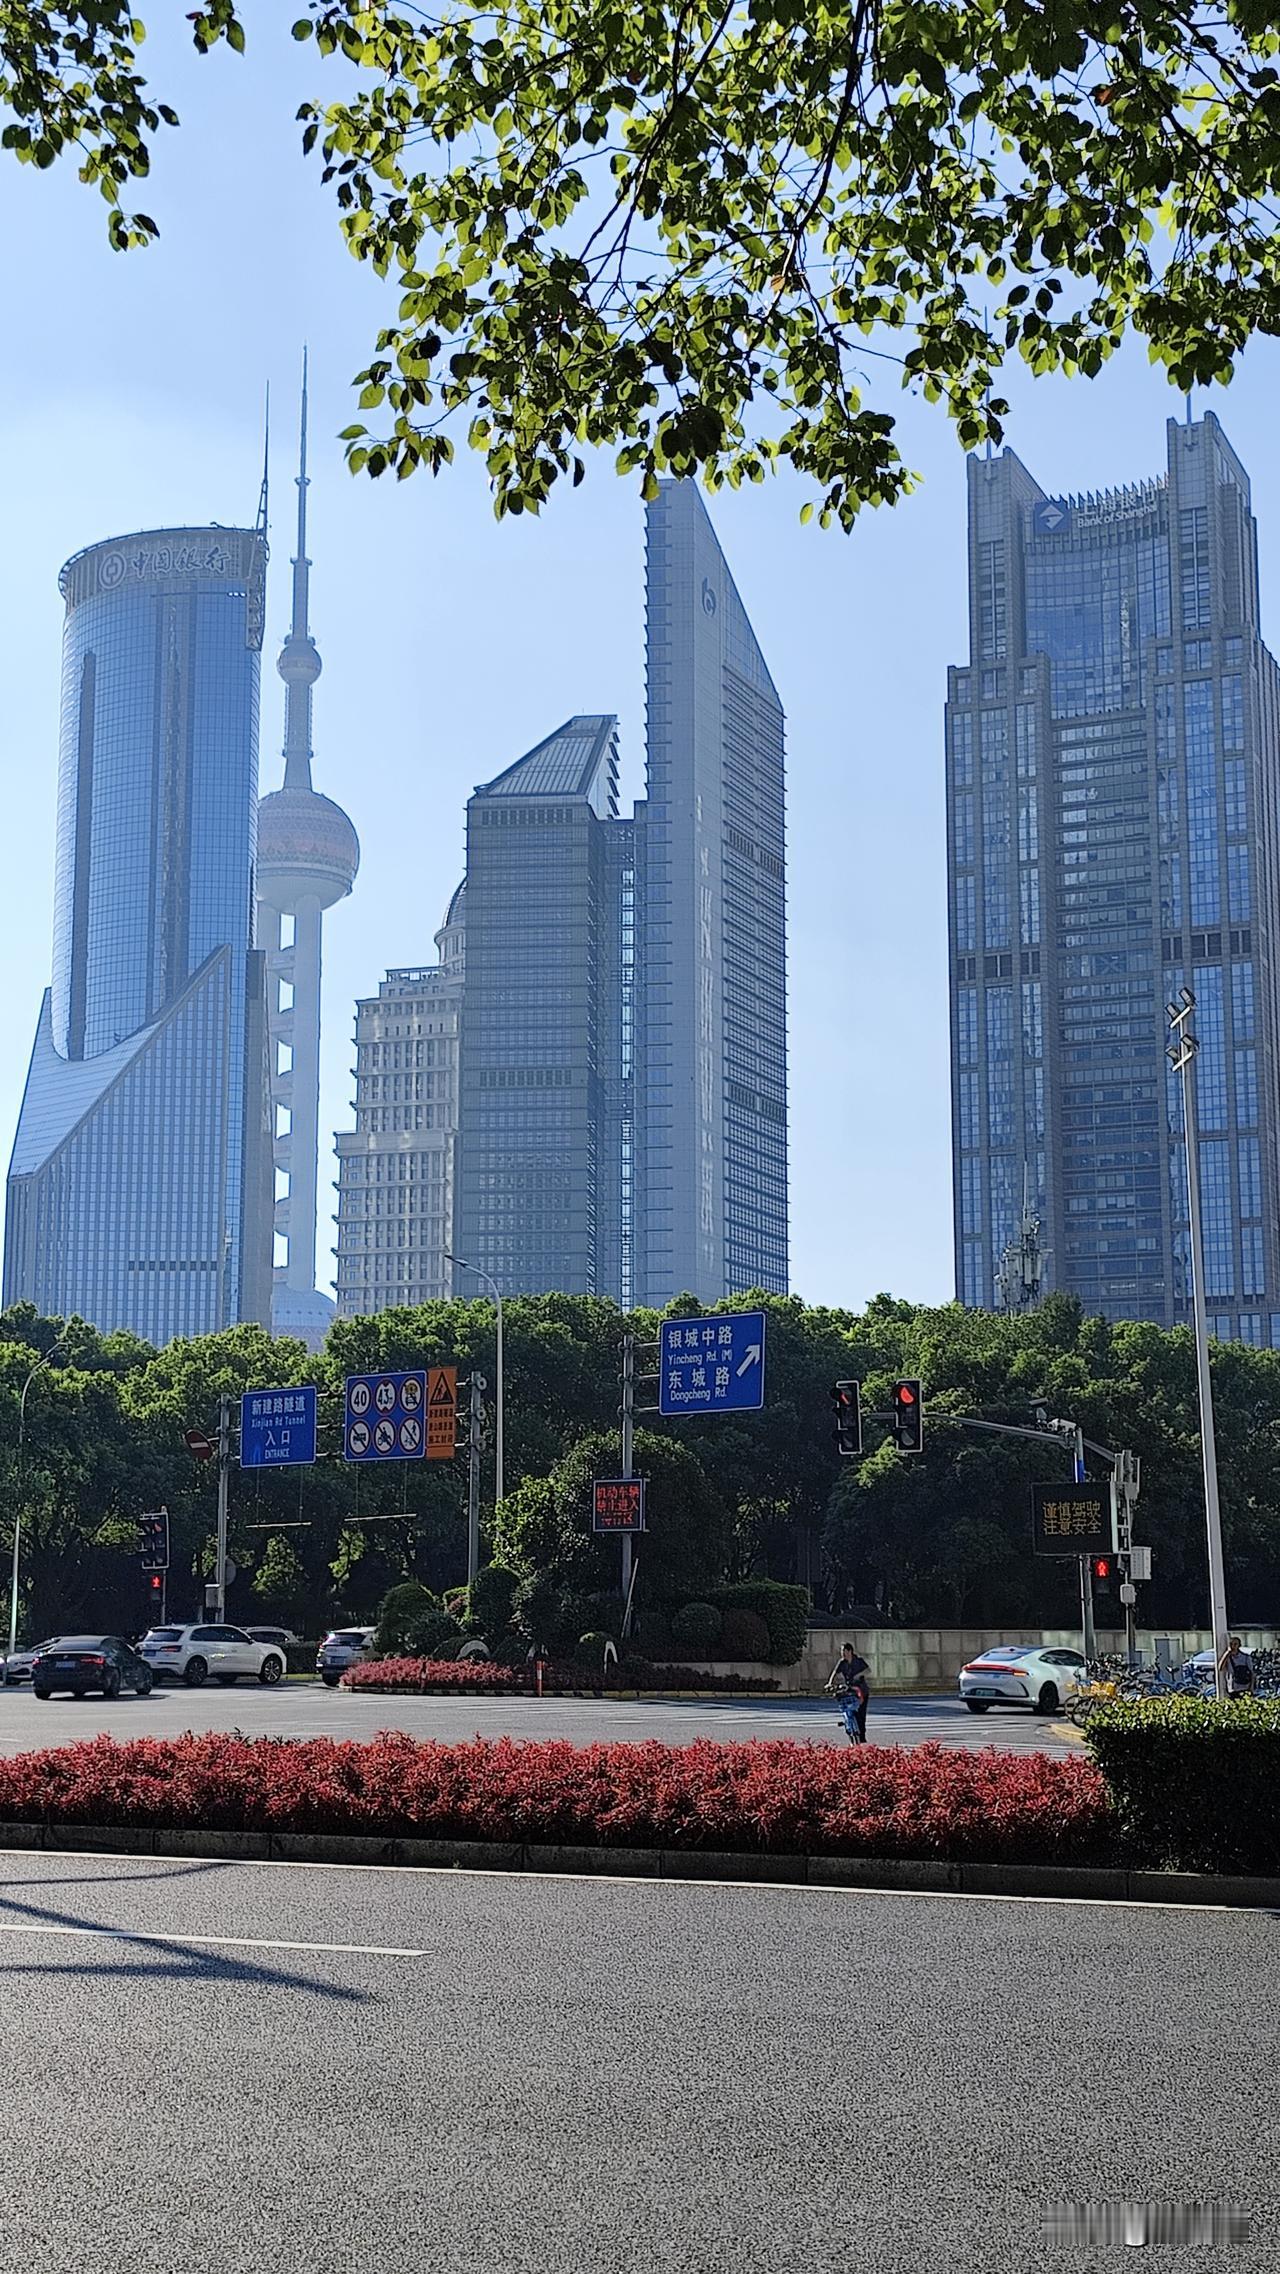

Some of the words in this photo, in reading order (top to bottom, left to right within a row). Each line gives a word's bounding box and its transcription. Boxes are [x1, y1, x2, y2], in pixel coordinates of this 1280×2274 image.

[1077, 515, 1103, 528] Bank
[1104, 512, 1115, 524] of
[1115, 503, 1157, 521] Shanghai
[132, 548, 232, 579] 中国银行
[667, 1325, 733, 1349] 银城中路
[667, 1353, 703, 1365] Yincheng
[668, 1366, 730, 1389] 东城路
[353, 1390, 367, 1407] 40
[670, 1389, 711, 1403] Dongcheng
[251, 1395, 306, 1416] 新建路隧道
[265, 1430, 290, 1447] 入口
[264, 1448, 290, 1459] ENTRANCE
[1042, 1500, 1101, 1518] 谨慎驾驶
[1042, 1518, 1102, 1536] 注意安全
